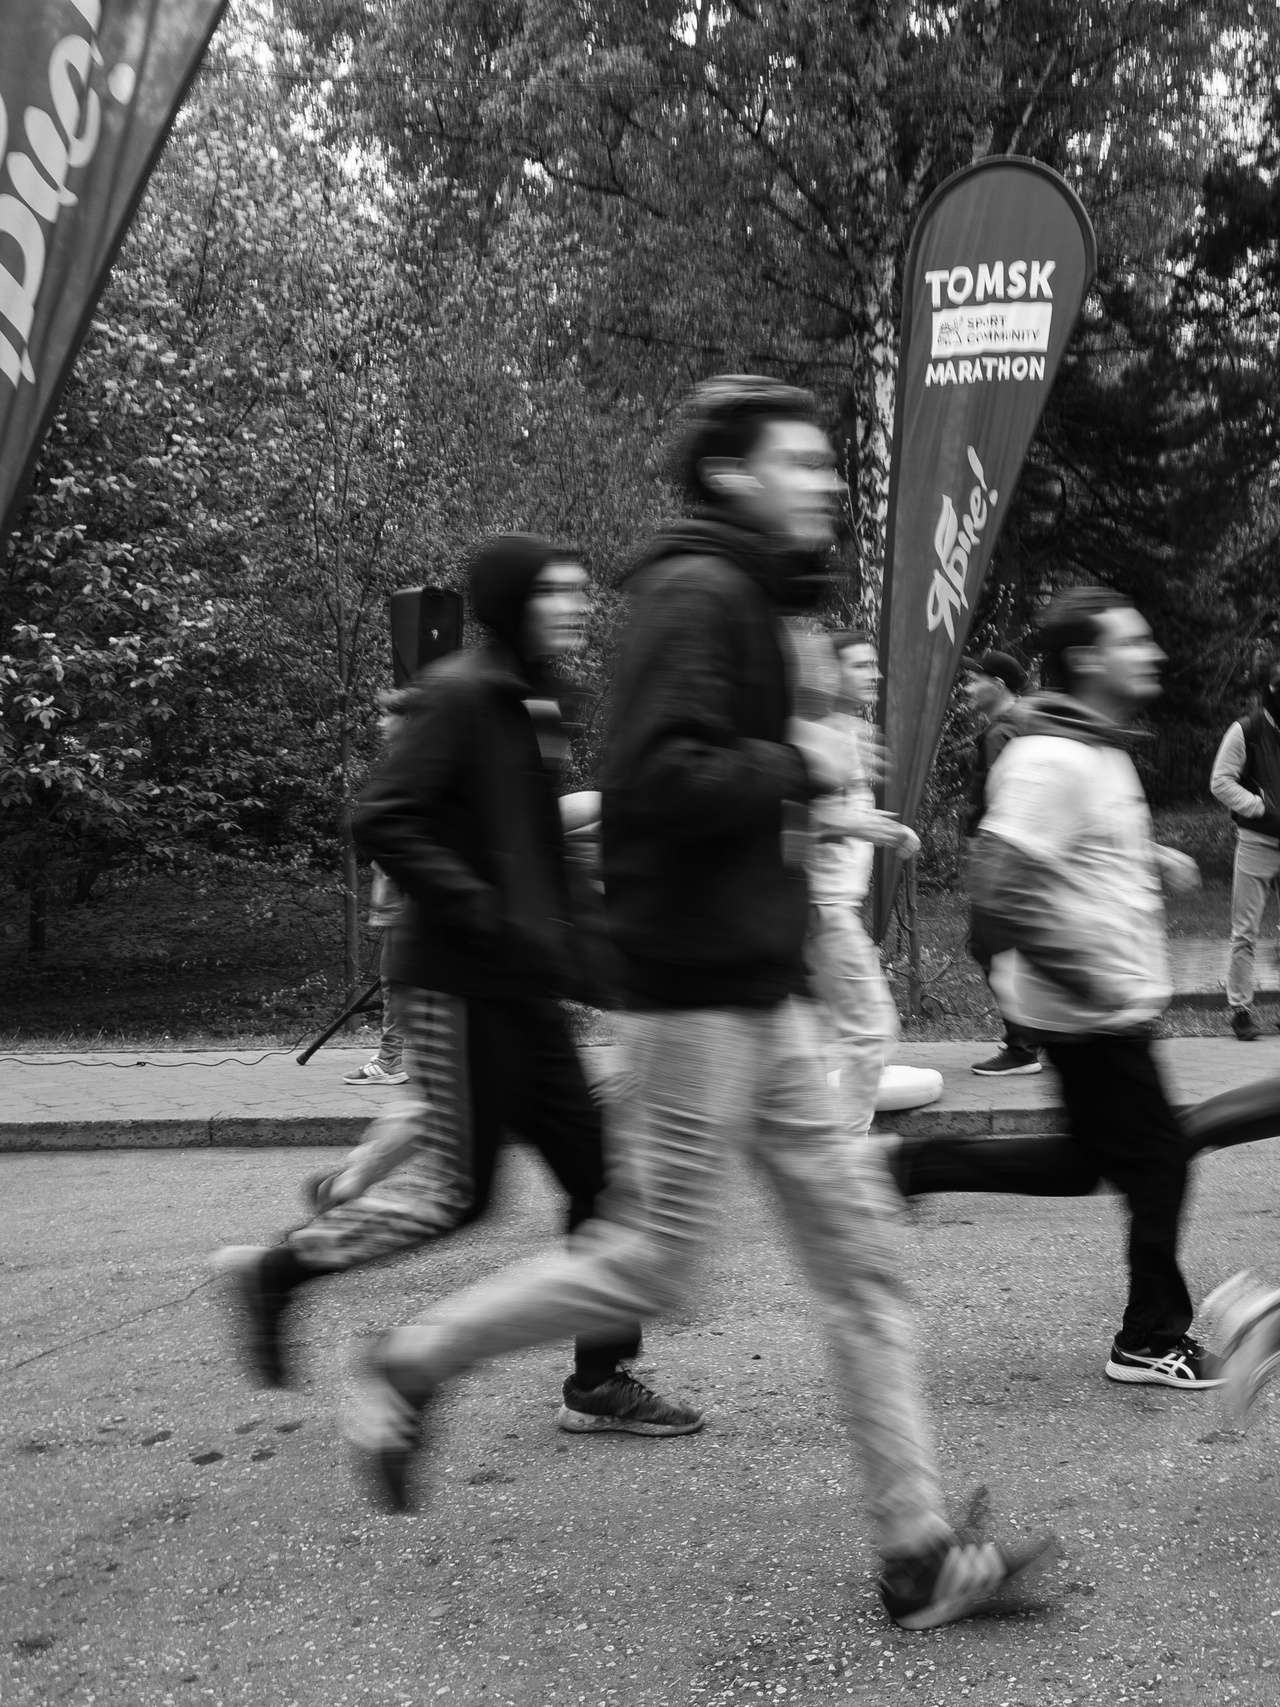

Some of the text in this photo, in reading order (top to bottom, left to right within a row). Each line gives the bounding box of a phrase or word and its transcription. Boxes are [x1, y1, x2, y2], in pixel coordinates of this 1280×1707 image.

[925, 259, 1056, 308] TOMSK
[967, 314, 1007, 330] SPORT
[967, 328, 1040, 346] COMMUNITY
[925, 355, 1046, 387] MARATHON
[927, 445, 998, 646] Ярче!
